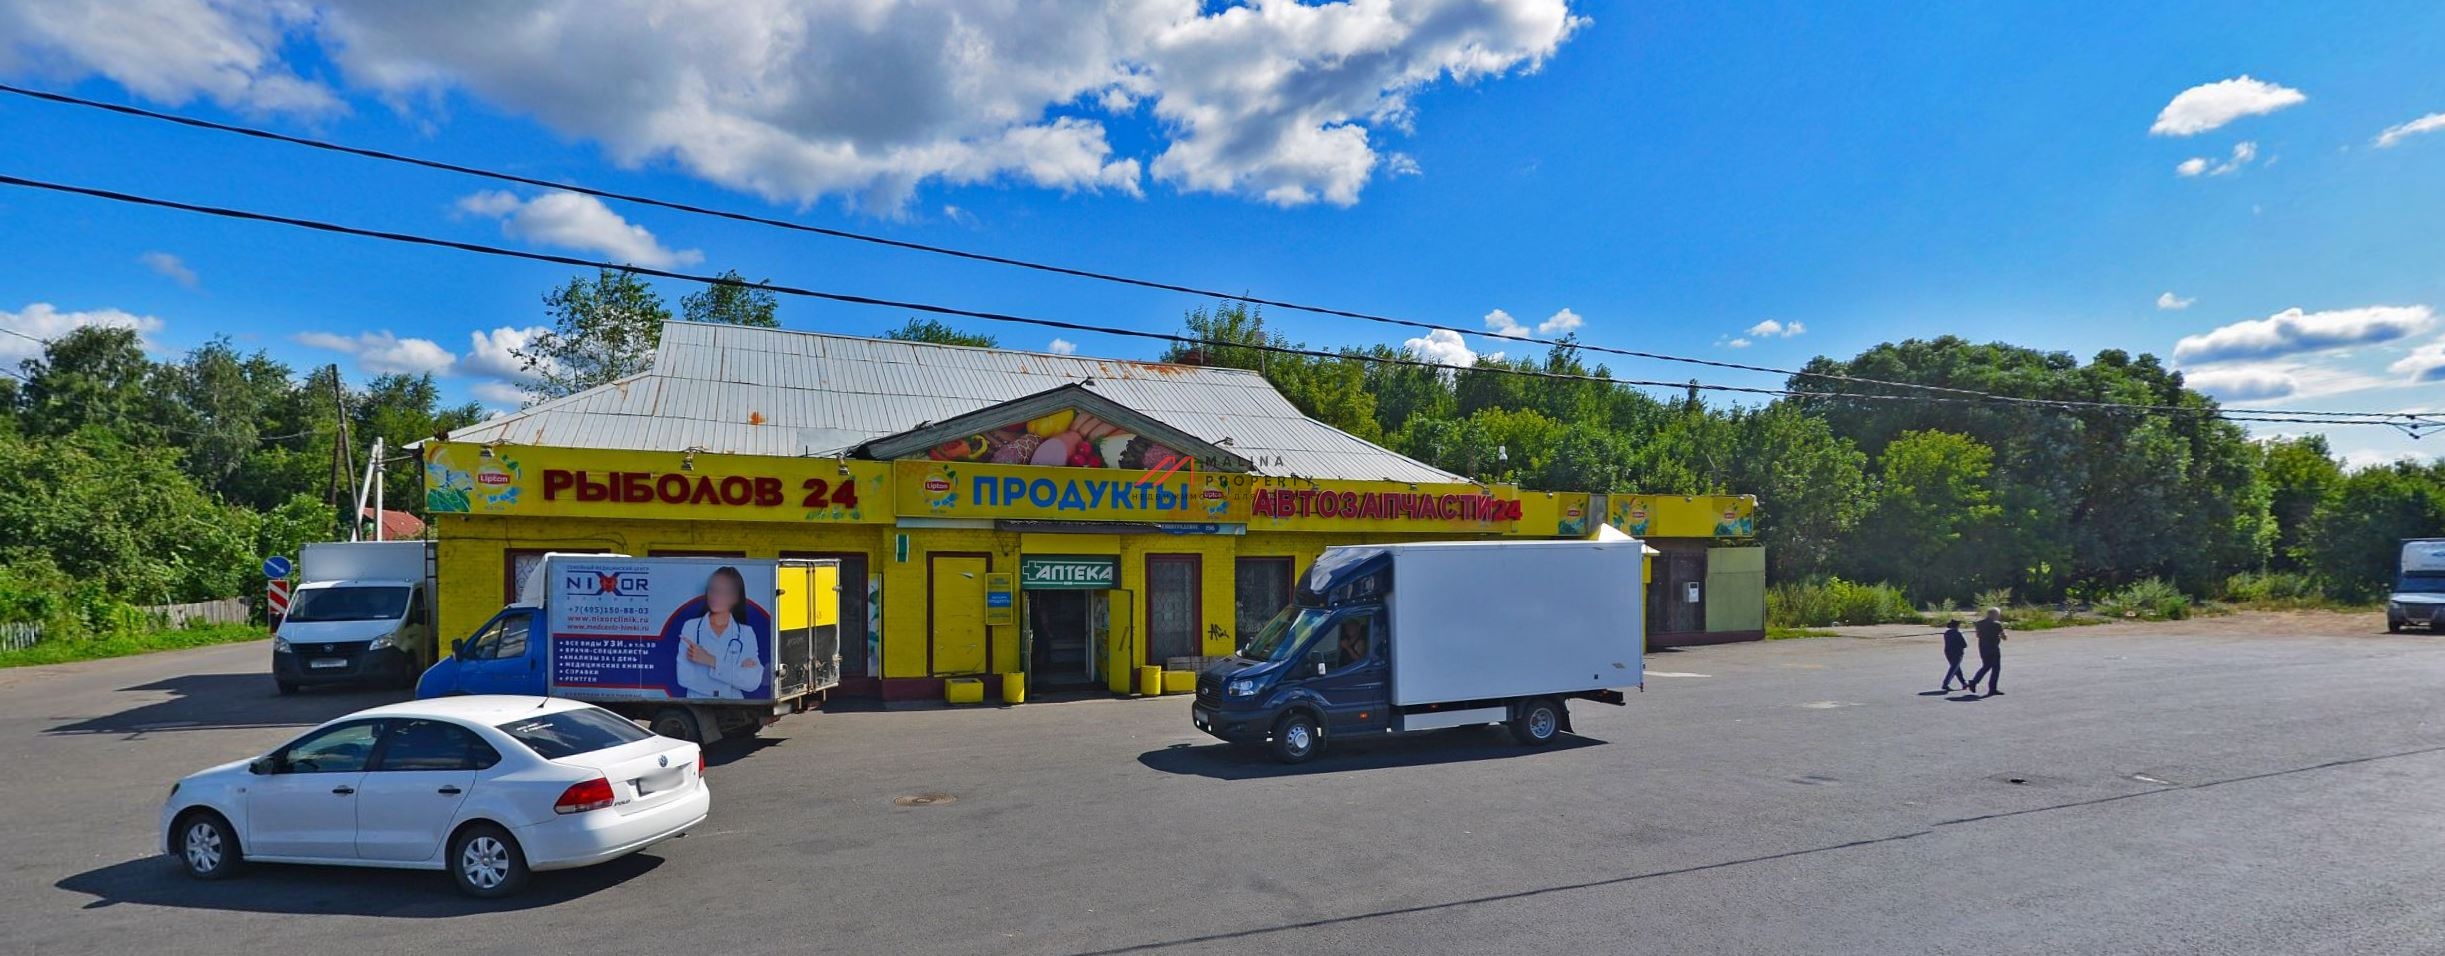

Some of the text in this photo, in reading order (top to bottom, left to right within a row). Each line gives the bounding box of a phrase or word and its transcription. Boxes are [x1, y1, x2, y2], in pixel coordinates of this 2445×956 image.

[480, 474, 508, 484] Lipton
[542, 469, 859, 509] РЫБОЛОВ 24
[972, 475, 1189, 511] ПРОДУКТЫ
[1252, 488, 1523, 521] АВТОЗАПЧАСТИ 24
[1035, 564, 1114, 581] АПТЕКА
[566, 573, 649, 593] NIXOR
[565, 647, 649, 655] ВРАЧИ-СПЕЦИАЛИСТЫ
